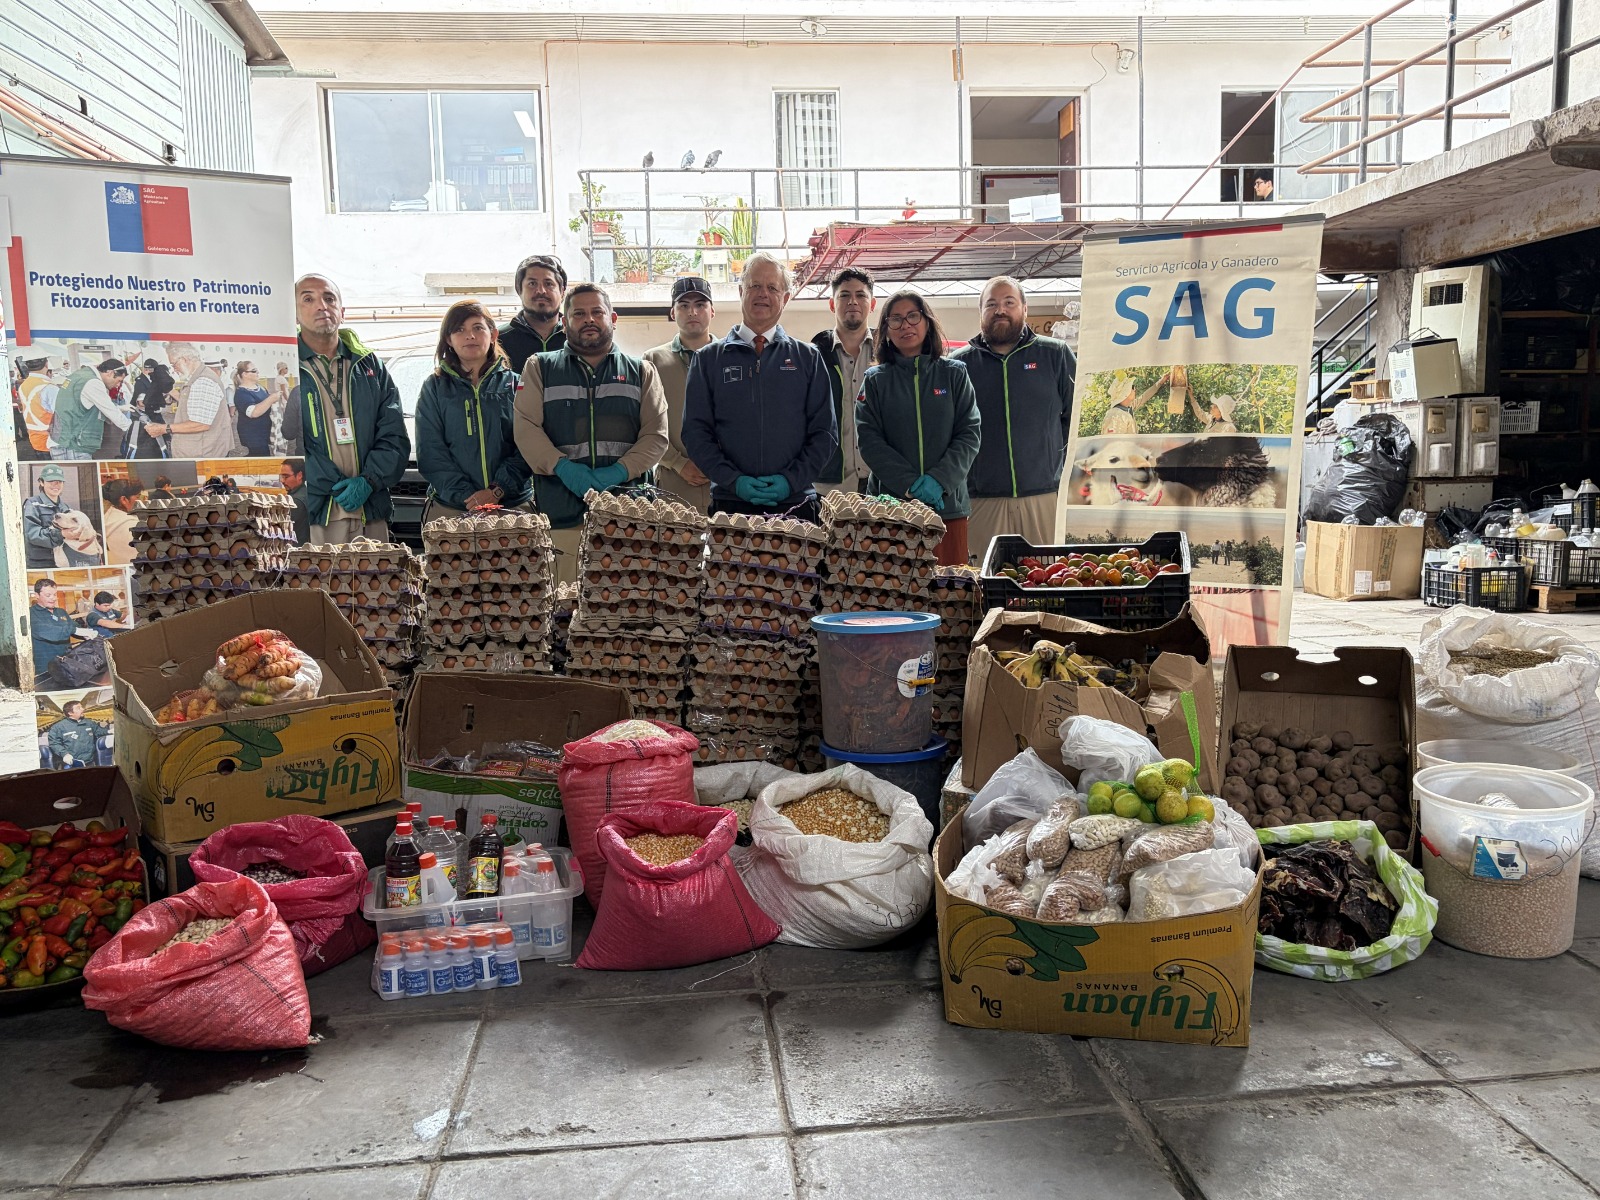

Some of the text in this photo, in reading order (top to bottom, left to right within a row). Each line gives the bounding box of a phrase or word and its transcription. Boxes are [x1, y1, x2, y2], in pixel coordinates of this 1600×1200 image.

[1115, 263, 1158, 277] Servicio
[1211, 260, 1218, 271] y
[1221, 255, 1279, 268] Ganadero
[29, 271, 272, 296] Protegiendo Nuestro Patrimonio
[51, 293, 260, 315] Fitozoosanitario en Frontera
[1111, 277, 1276, 345] SAG
[330, 706, 391, 721] Premium Bananas
[264, 756, 379, 801] Flyban
[1150, 924, 1233, 943] Premium Bananas
[1076, 982, 1138, 992] BANANAS
[1062, 985, 1218, 1030] Flyban
